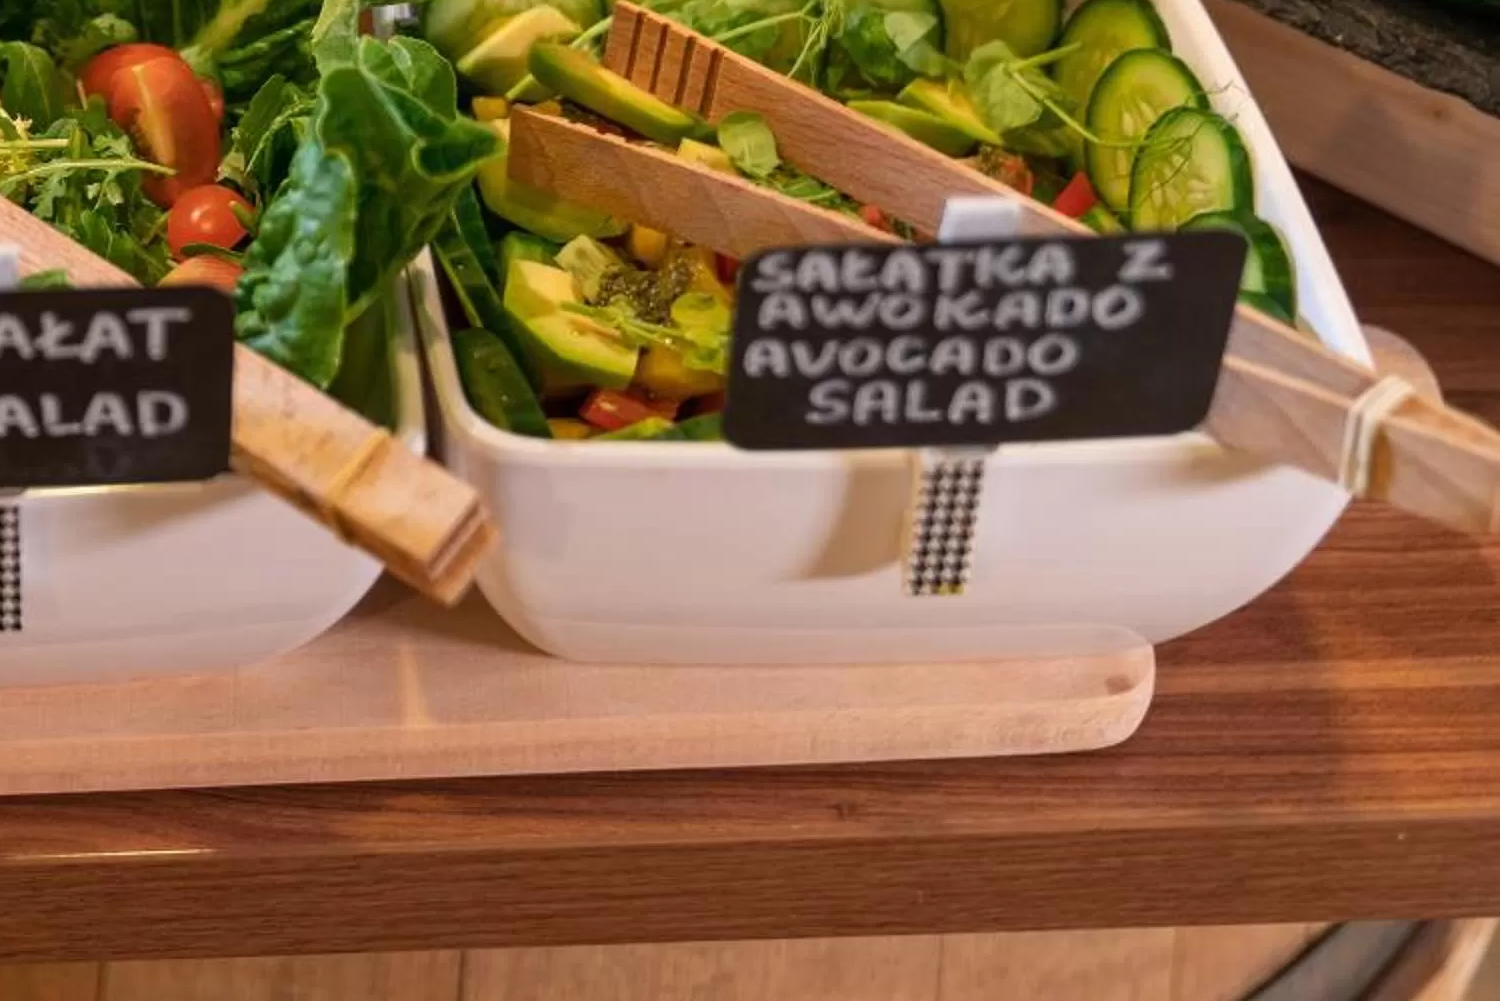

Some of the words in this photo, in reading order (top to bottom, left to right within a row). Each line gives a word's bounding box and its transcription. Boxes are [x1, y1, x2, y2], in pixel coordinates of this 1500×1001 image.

[752, 242, 1075, 293] SAŁATKA
[1118, 240, 1175, 282] Z
[757, 285, 1144, 331] AWOKADO
[743, 334, 1079, 377] AVOCADO
[804, 378, 1059, 425] SALAD
